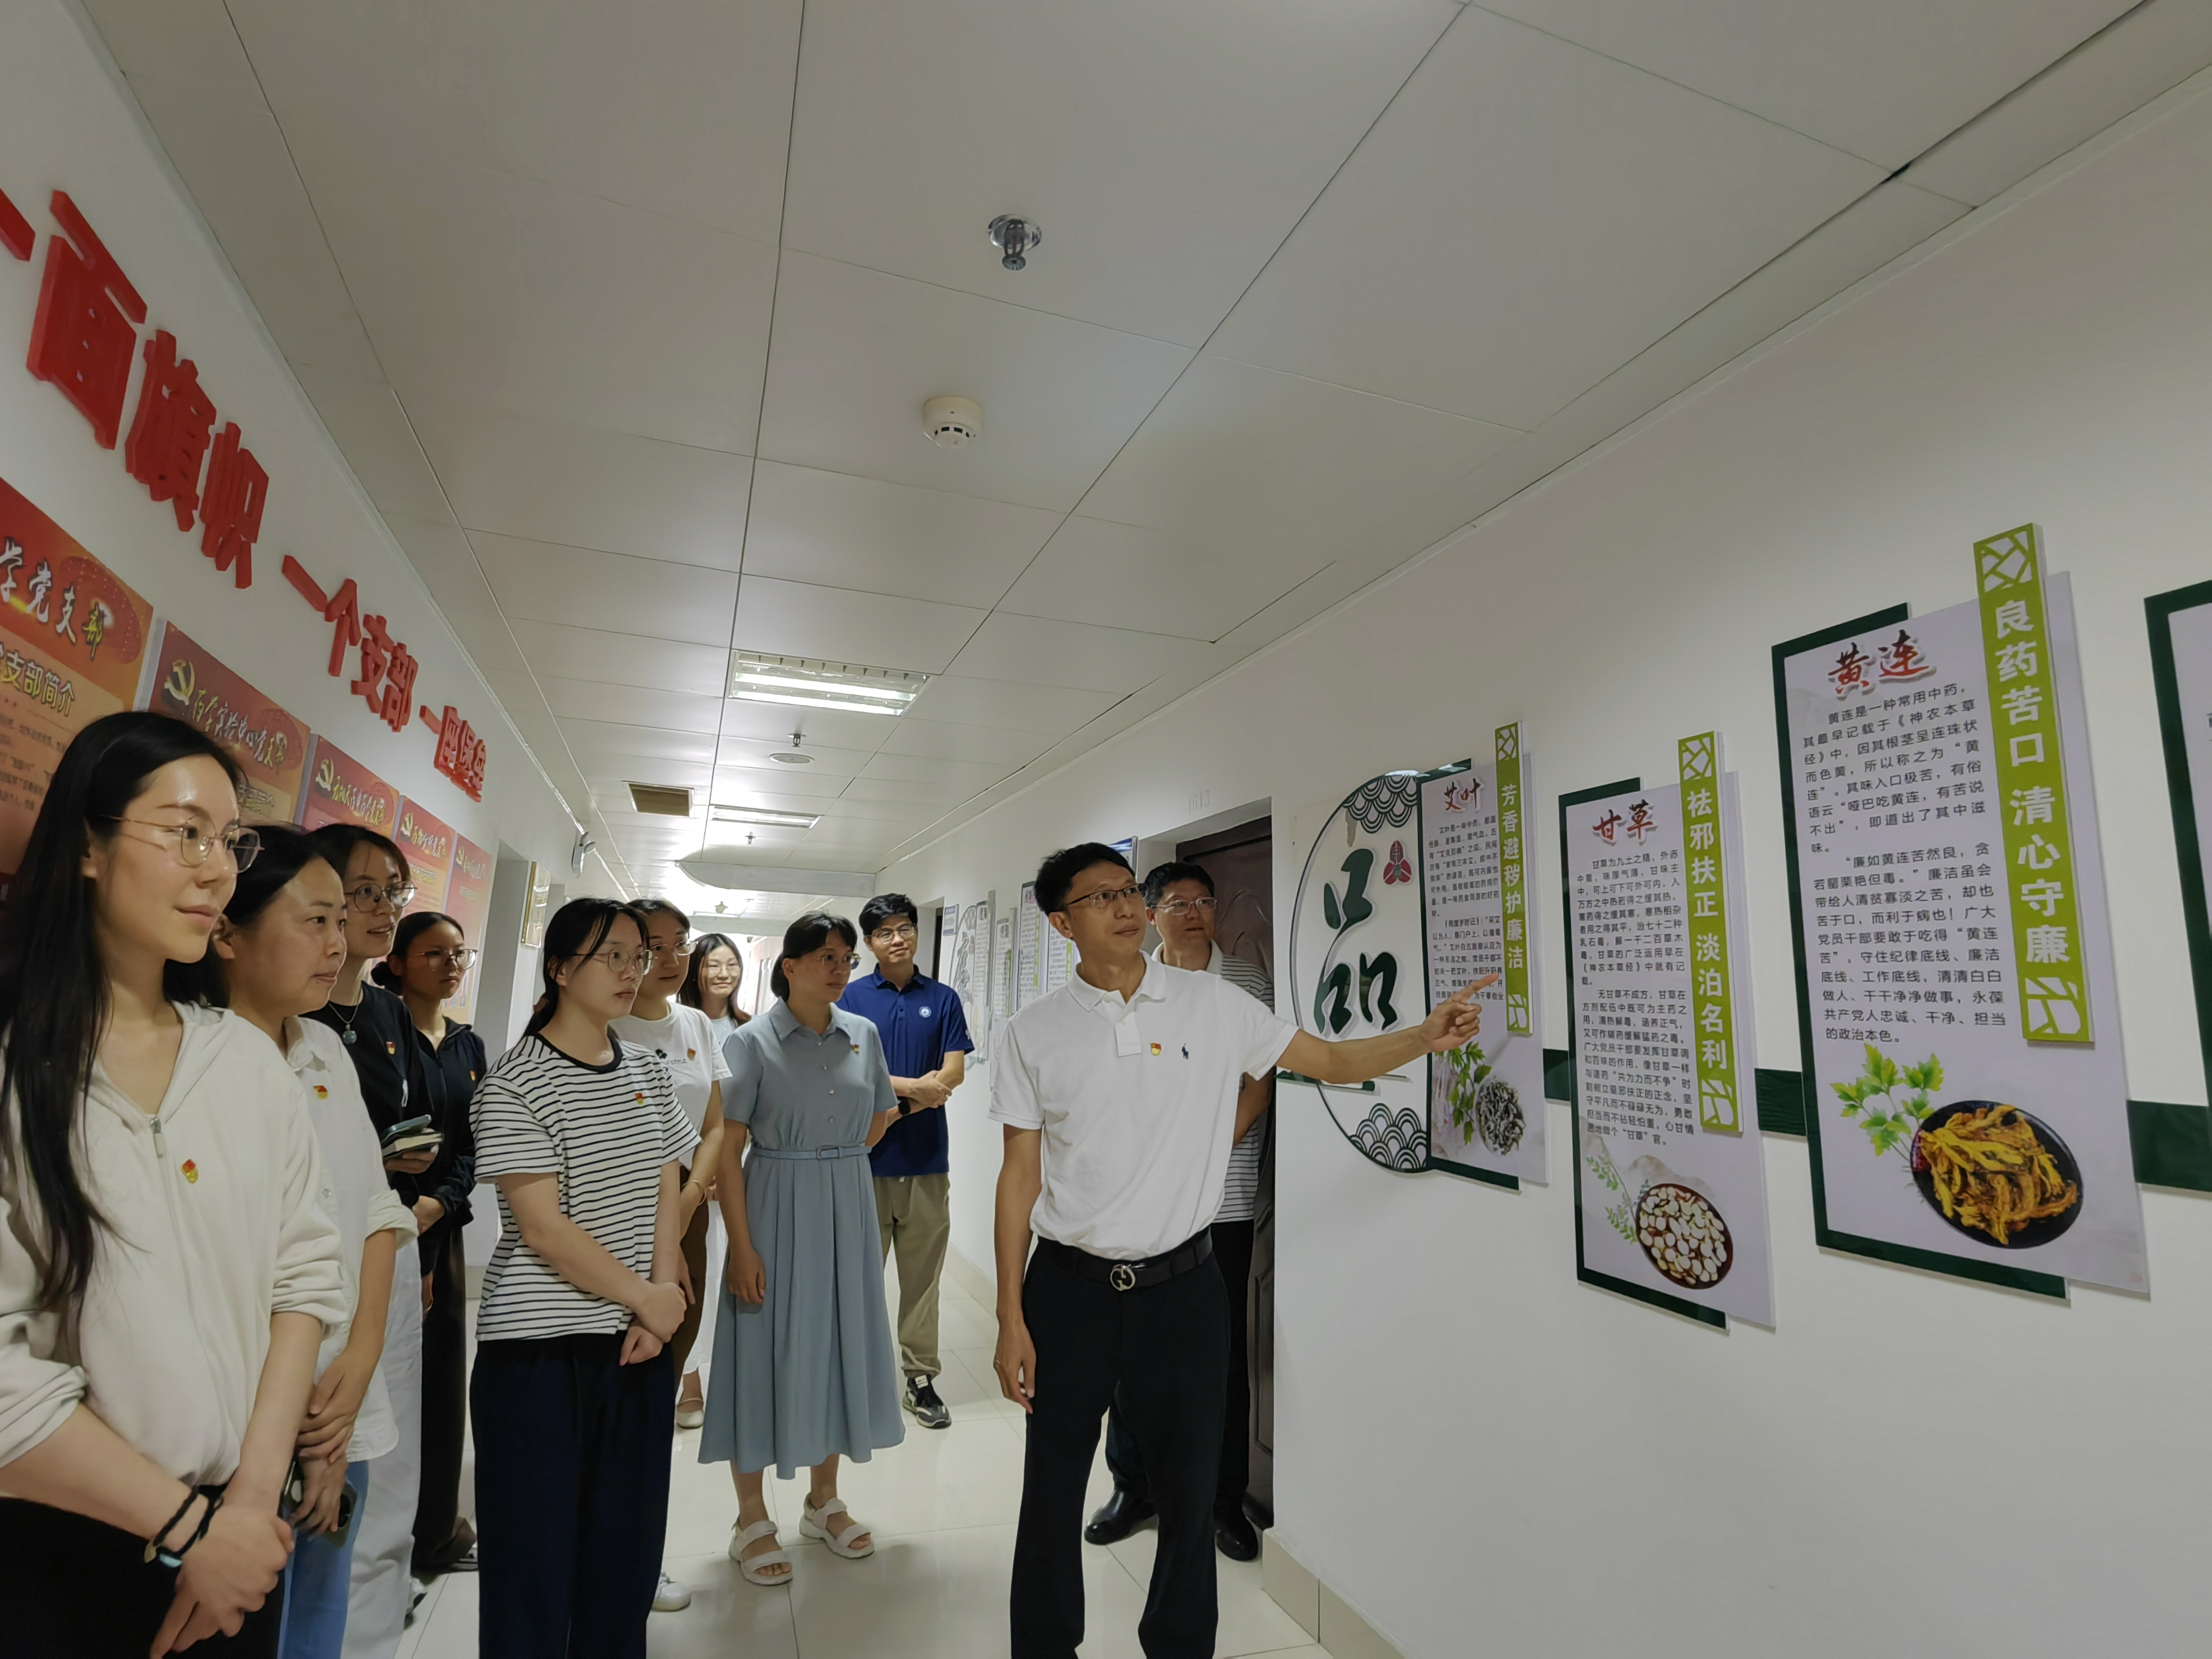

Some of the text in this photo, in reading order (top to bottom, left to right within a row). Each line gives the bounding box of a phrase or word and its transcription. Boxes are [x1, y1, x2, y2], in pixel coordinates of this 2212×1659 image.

[0, 642, 75, 717] 支部简介
[282, 555, 419, 732] 一个支部
[1828, 630, 1930, 694] 黄连
[1444, 778, 1481, 811] 艾叶
[1995, 599, 2071, 964] 良药苦口 清心守廉
[1593, 799, 1654, 840] 甘草
[1687, 790, 1727, 1069] 祛邪扶正 淡泊名利
